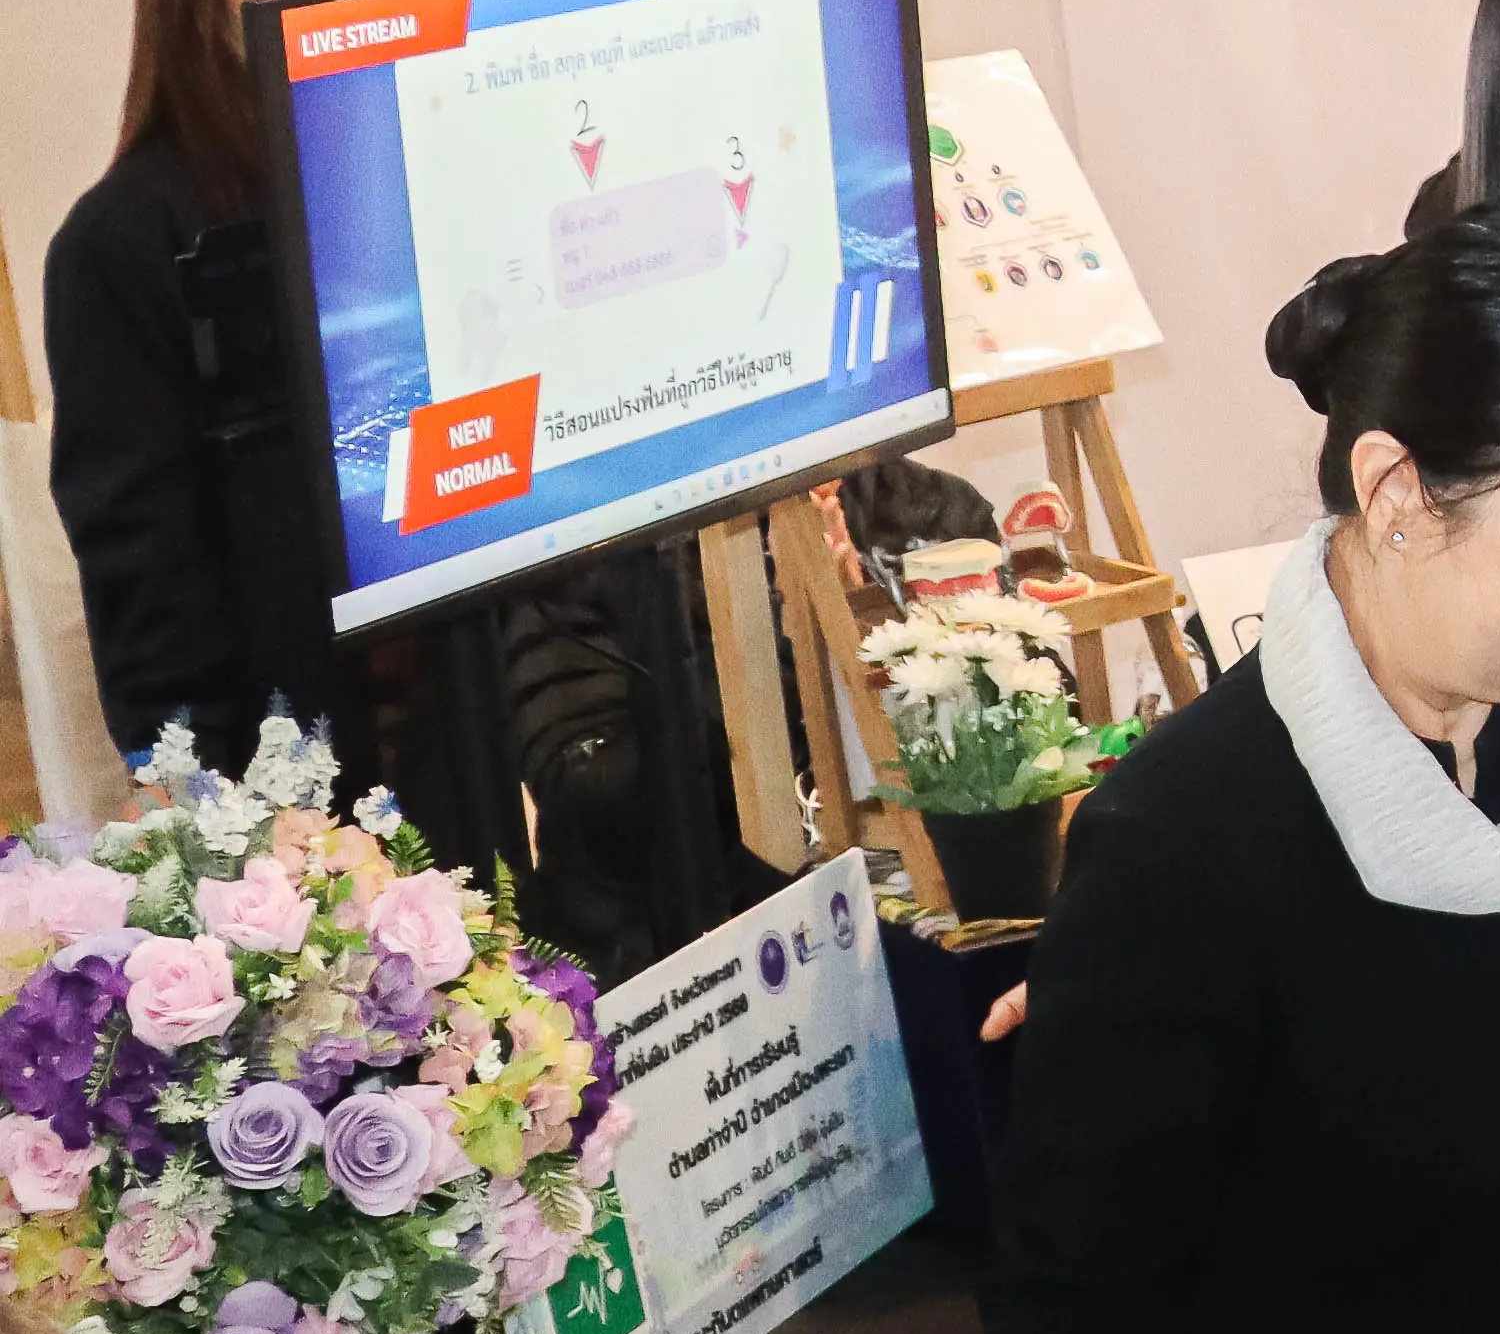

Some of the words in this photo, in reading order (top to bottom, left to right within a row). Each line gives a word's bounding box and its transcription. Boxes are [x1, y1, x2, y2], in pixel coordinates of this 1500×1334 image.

[300, 27, 347, 59] LIVE
[347, 13, 418, 51] STREAM
[574, 99, 597, 137] 2
[726, 136, 746, 171] 3
[544, 347, 794, 443] วิธีสอนแปรงฟันที่ถูกวิธีให้ผู้สูงอายุ
[447, 415, 495, 453] NEW
[433, 450, 518, 498] NORMAL
